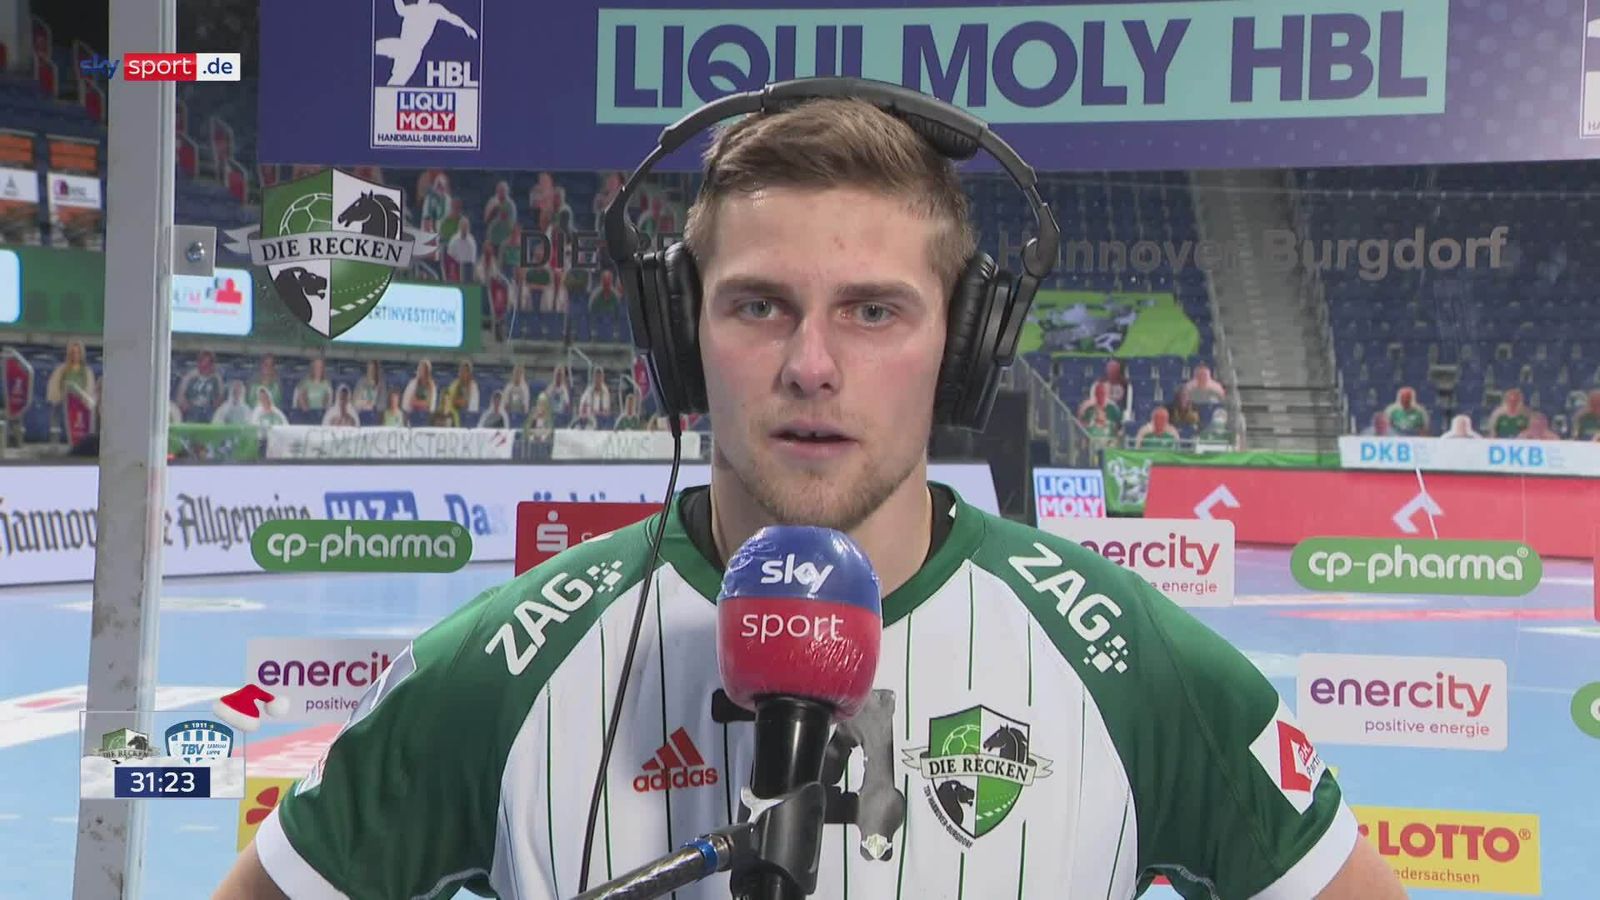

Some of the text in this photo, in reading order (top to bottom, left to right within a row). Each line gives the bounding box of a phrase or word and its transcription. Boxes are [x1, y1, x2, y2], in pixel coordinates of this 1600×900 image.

[614, 11, 1428, 108] LIQUI MOLY HBL
[426, 60, 479, 87] HBL
[399, 92, 455, 112] LIQUI
[399, 112, 455, 131] MOLY
[261, 237, 404, 262] DIE RECKEN
[520, 230, 600, 268] DIE
[1000, 230, 1242, 273] Hnnover
[1262, 226, 1509, 281] Burgdorf
[1360, 441, 1412, 463] DKB
[1488, 444, 1545, 467] DKB
[1039, 476, 1100, 496] LIQUI
[1039, 496, 1103, 518] MOLY
[760, 553, 834, 594] sky
[1008, 542, 1122, 641] ZAG
[1162, 580, 1218, 596] energie
[484, 572, 594, 676] ZAG
[741, 613, 844, 644] sport
[305, 696, 359, 713] positive
[1310, 671, 1492, 718] enercity
[1364, 718, 1490, 738] positive energie
[632, 767, 719, 793] adidas
[928, 757, 1030, 783] DIE RECKEN
